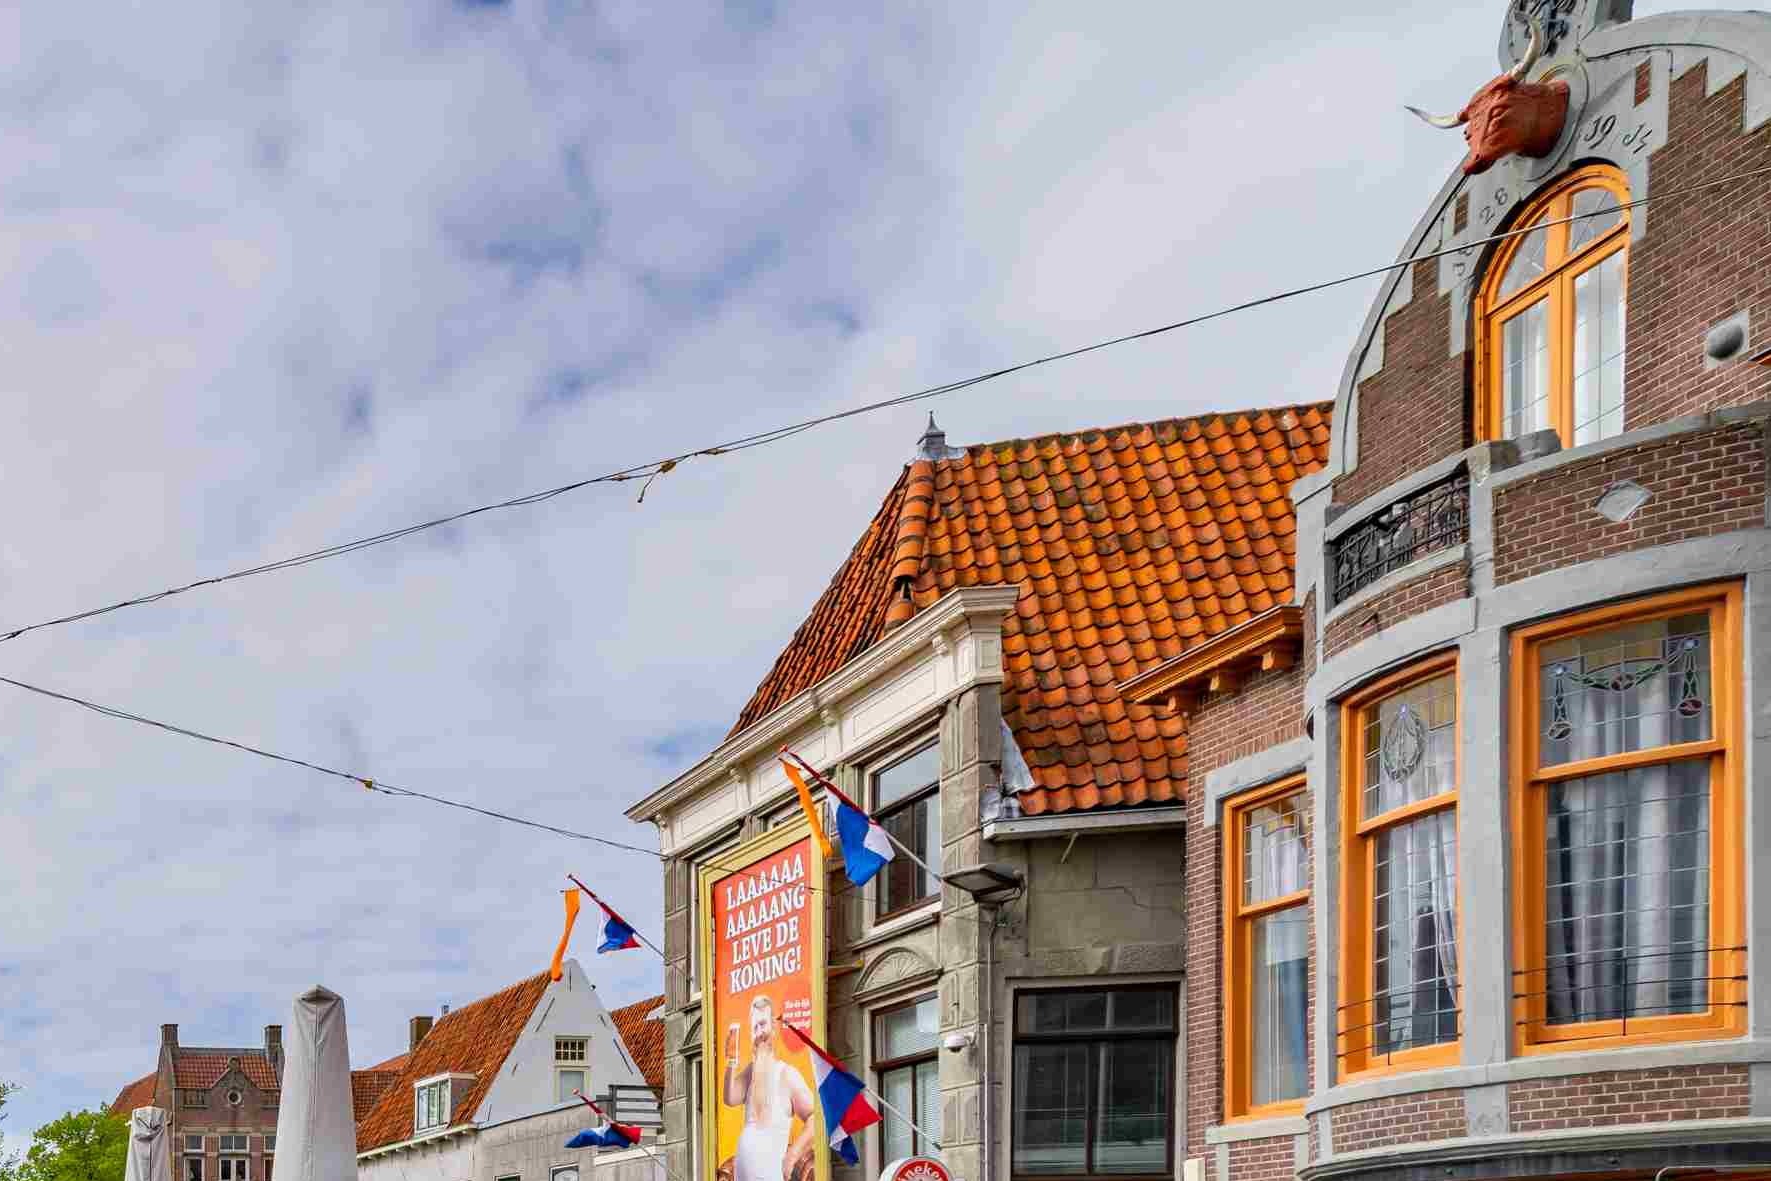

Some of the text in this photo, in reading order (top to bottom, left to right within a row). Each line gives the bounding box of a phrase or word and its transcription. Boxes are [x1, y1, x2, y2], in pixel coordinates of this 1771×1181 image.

[726, 853, 805, 911] LAAAAAA
[725, 883, 805, 940] AAAAANG
[731, 916, 800, 965] LEVE DE
[729, 946, 802, 994] KONING!
